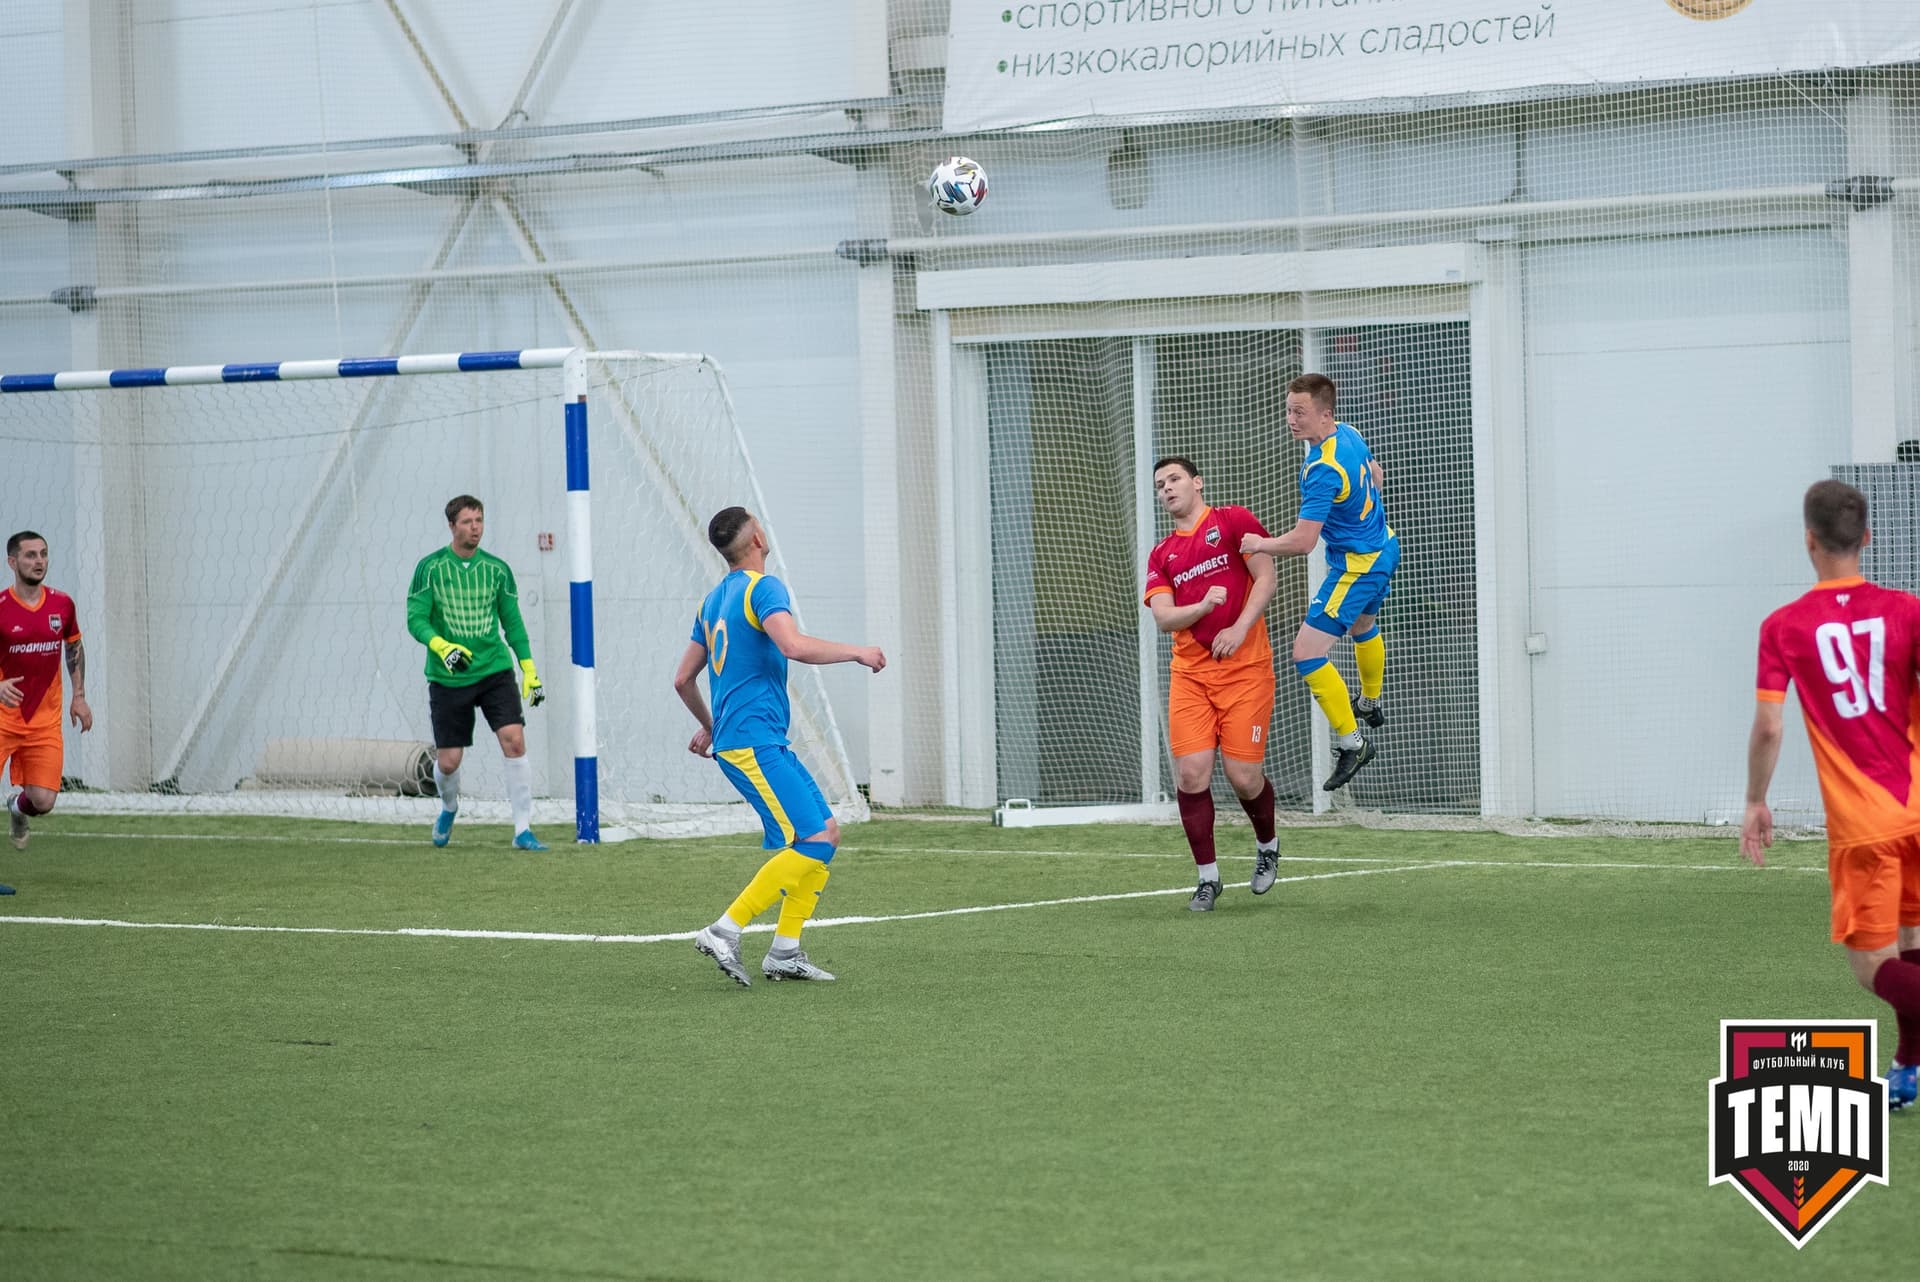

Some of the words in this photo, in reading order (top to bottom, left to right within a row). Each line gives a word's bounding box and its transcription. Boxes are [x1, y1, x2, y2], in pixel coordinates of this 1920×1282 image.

[1012, 28, 1346, 77] низкокалорийных
[1360, 4, 1555, 54] сладостей
[1173, 553, 1229, 589] ПРОДИНВЕСТ
[1815, 616, 1887, 718] 97
[1251, 725, 1262, 743] 13
